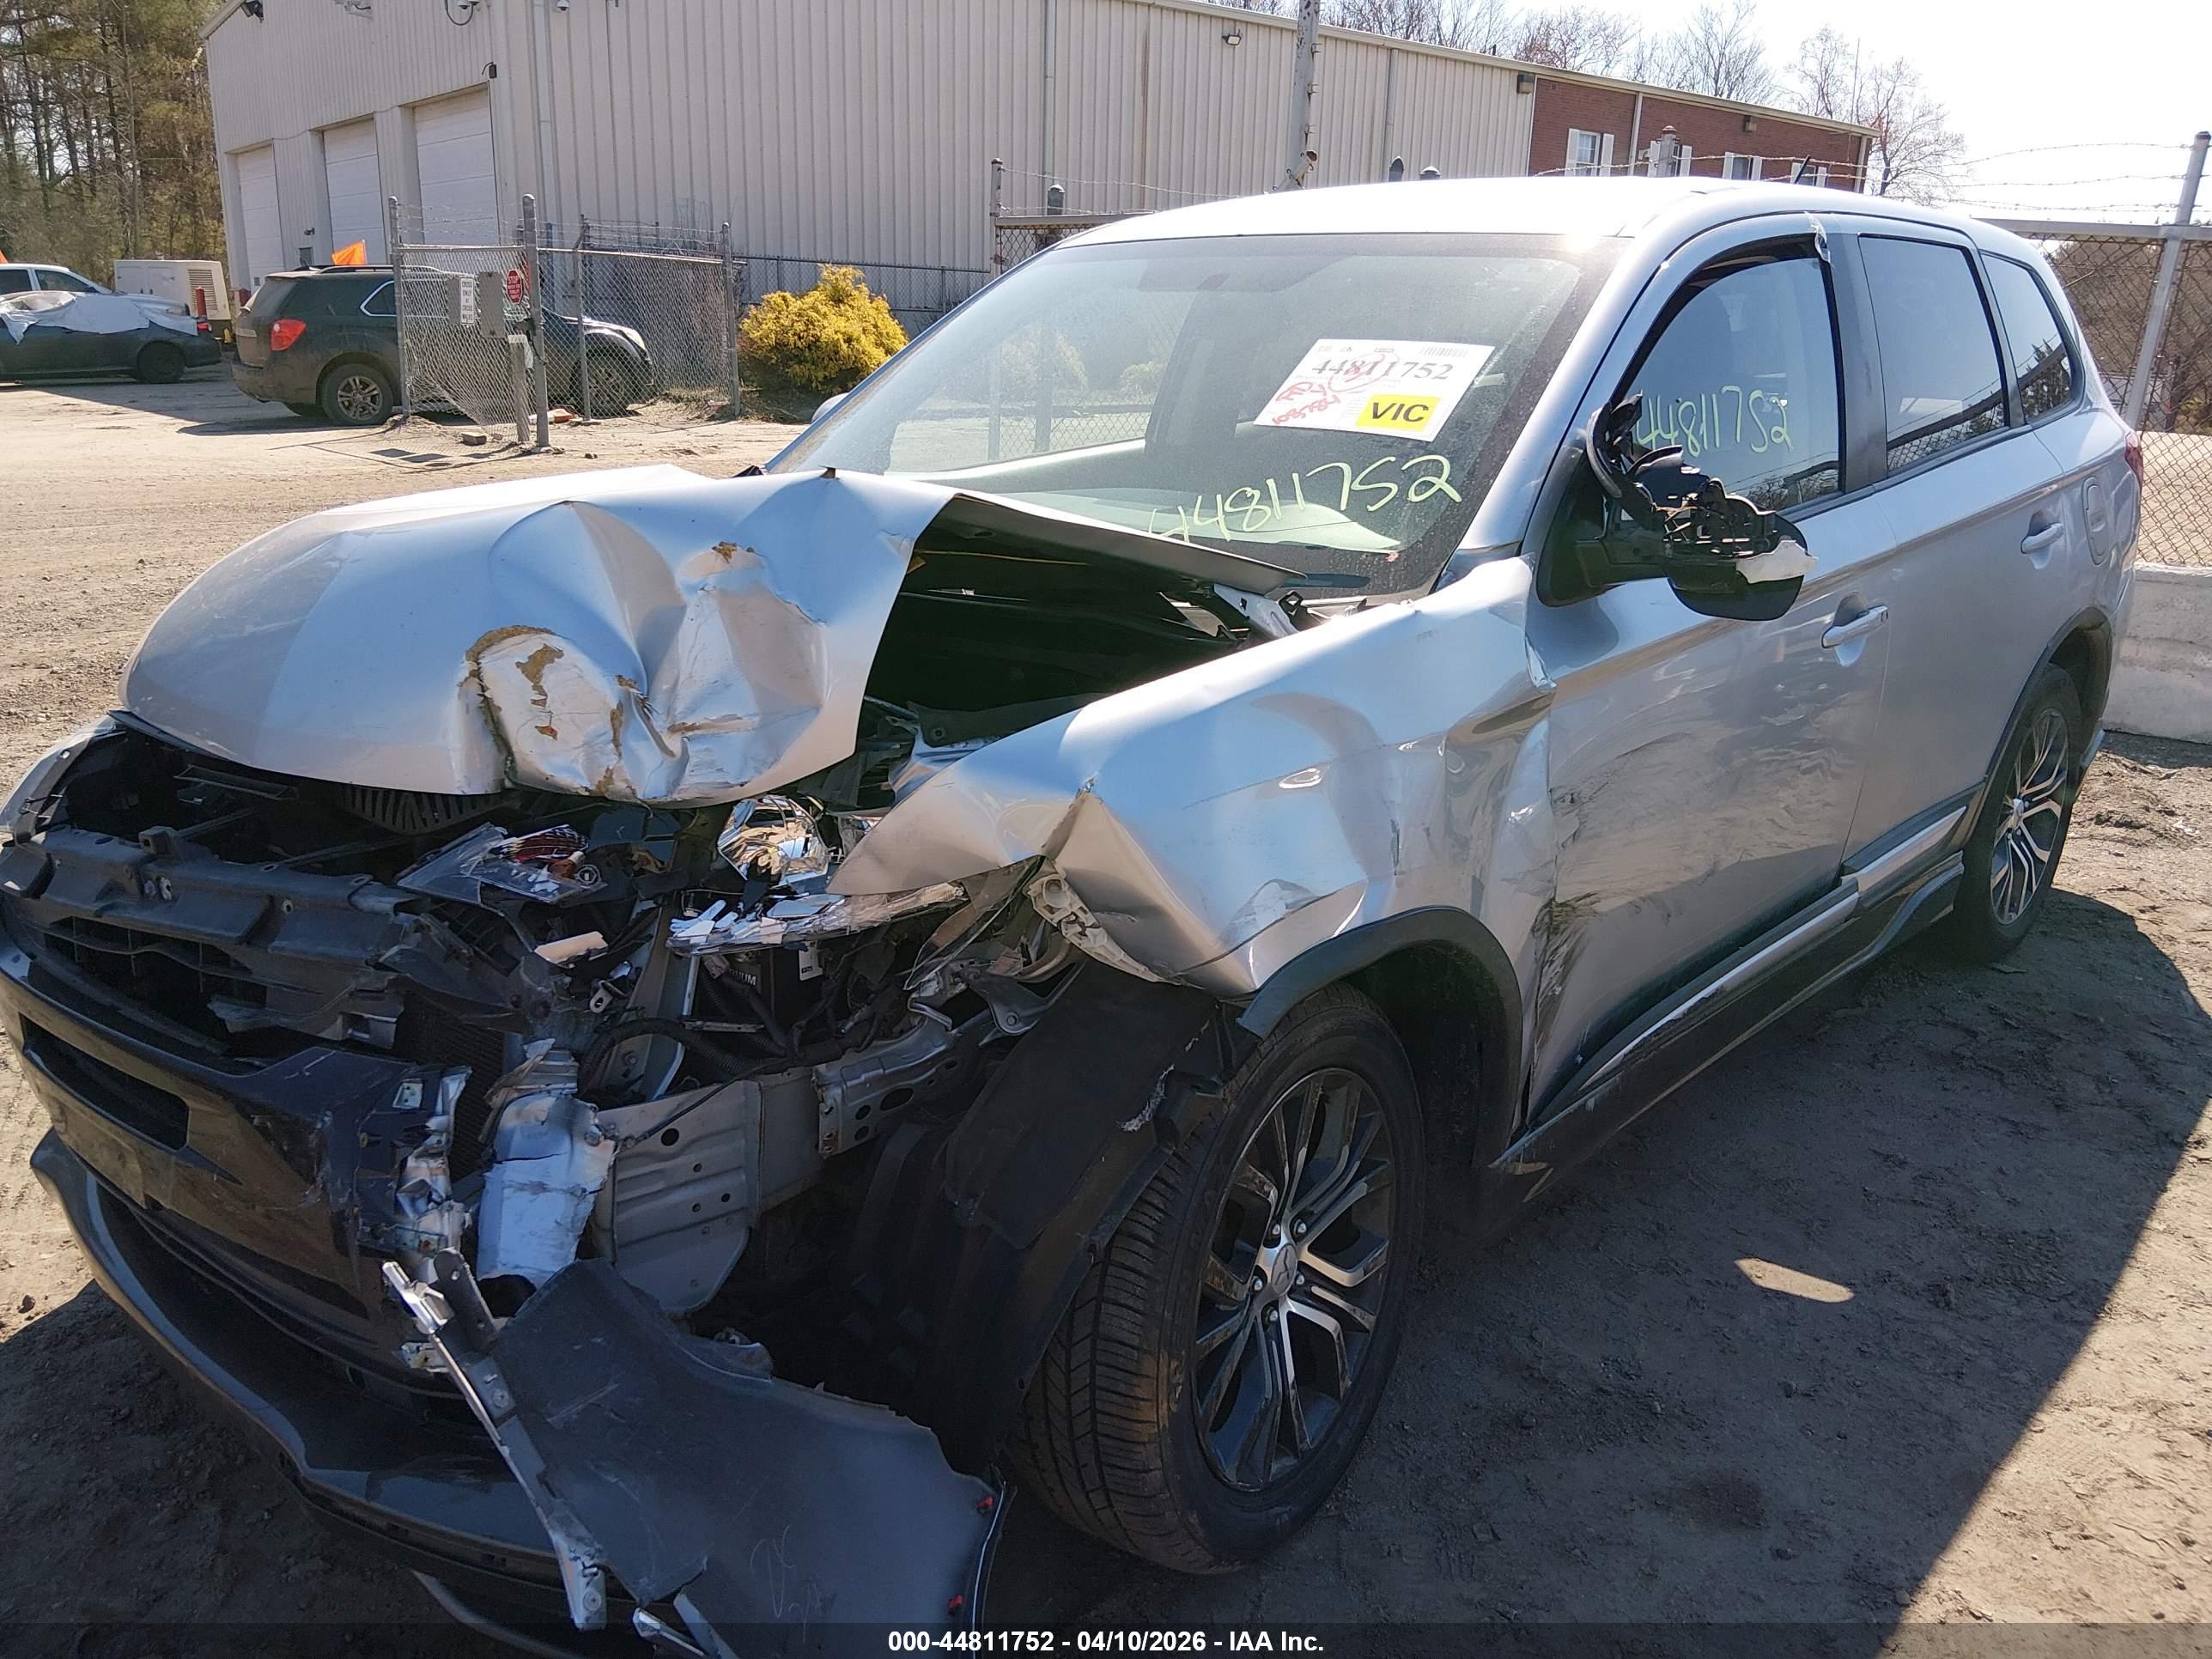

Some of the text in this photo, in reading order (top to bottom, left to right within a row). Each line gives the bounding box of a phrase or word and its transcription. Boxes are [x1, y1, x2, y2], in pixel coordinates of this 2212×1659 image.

[507, 275, 520, 284] STOP
[1312, 359, 1454, 380] 44811752
[1371, 393, 1429, 422] VIC
[1635, 385, 1794, 457] 44811752
[1148, 454, 1462, 544] 44811752
